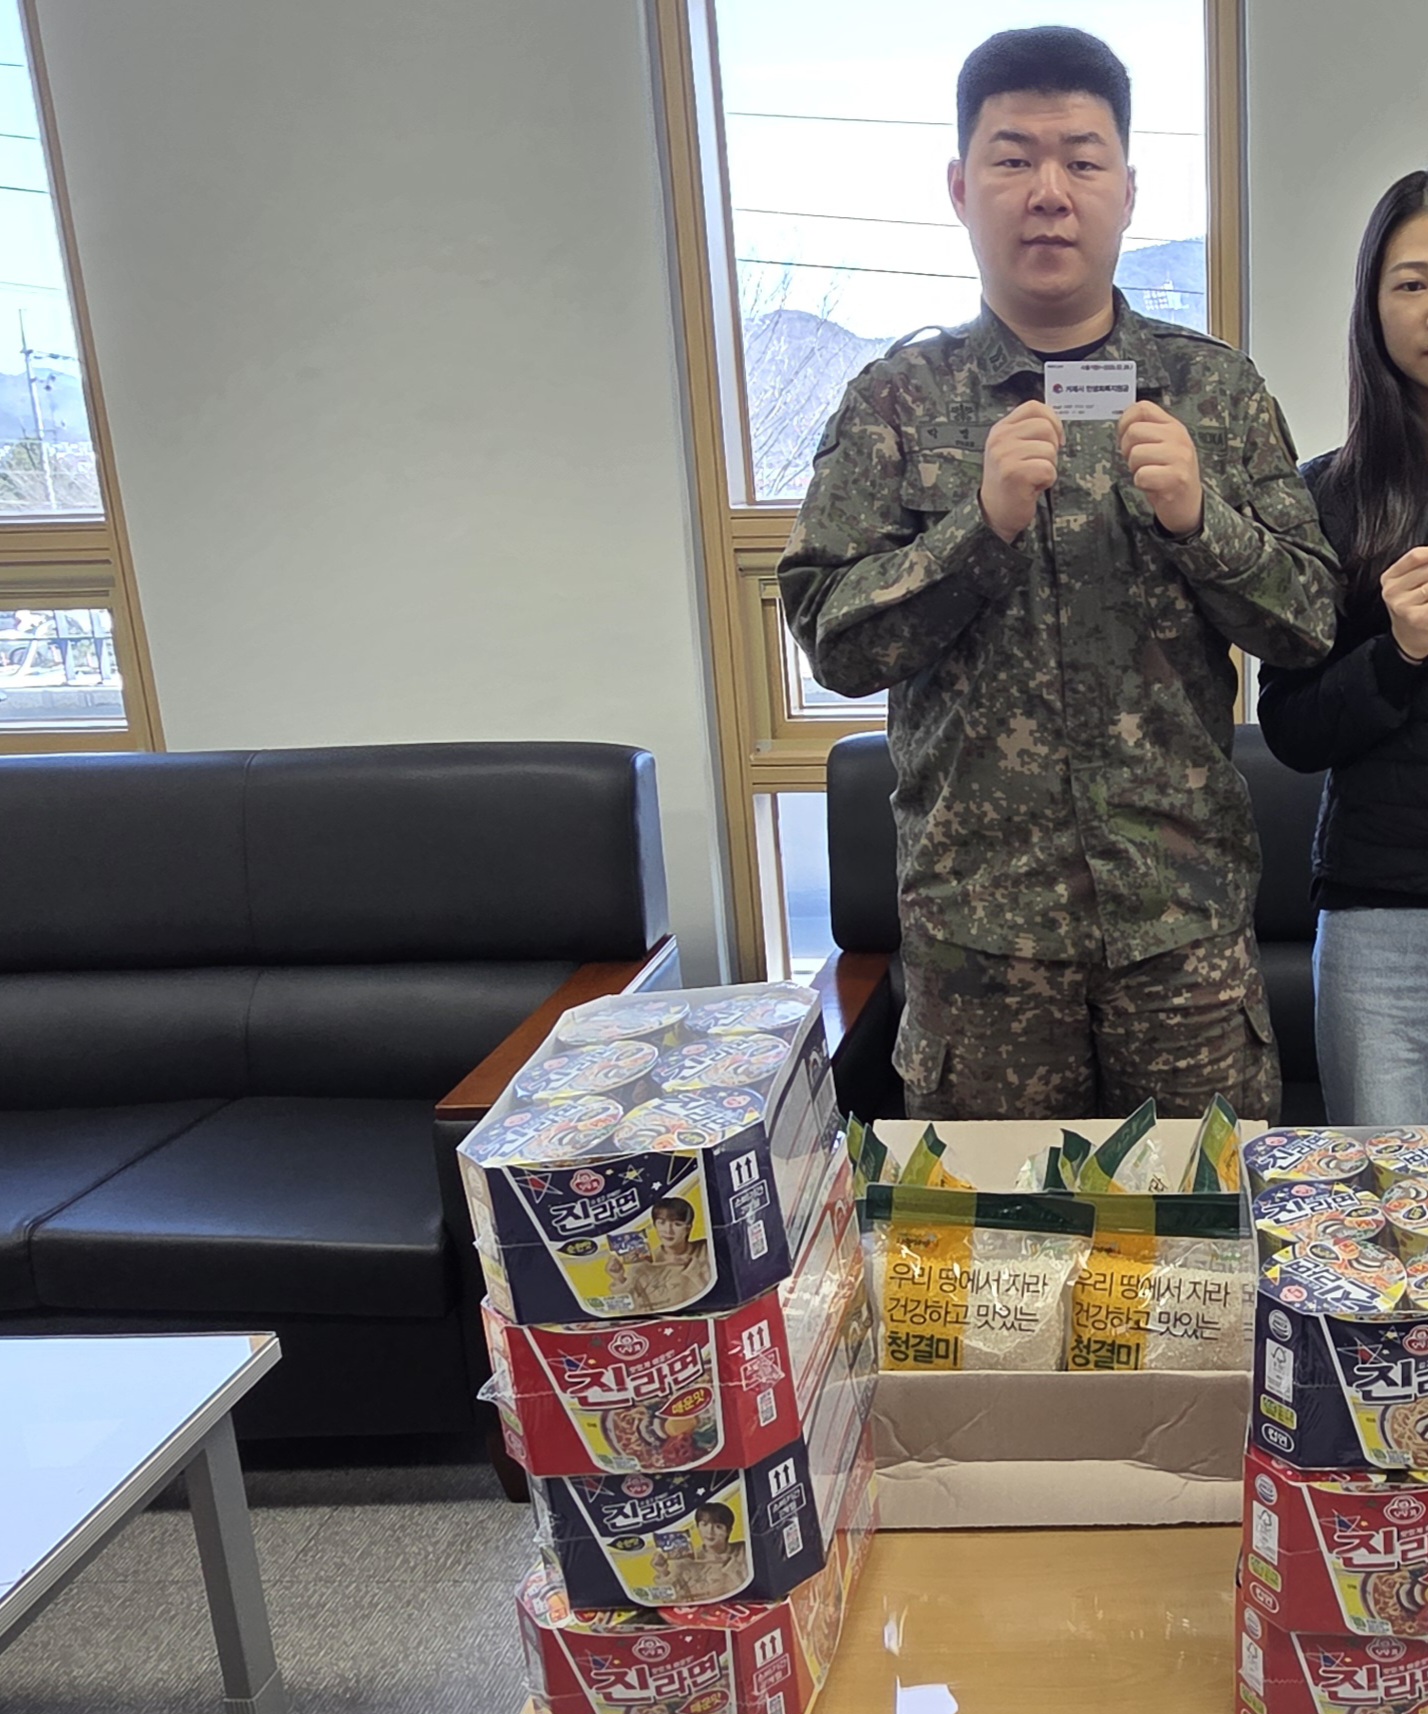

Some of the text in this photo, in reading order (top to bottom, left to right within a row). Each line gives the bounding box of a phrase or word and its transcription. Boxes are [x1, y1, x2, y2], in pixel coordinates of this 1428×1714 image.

[550, 1187, 641, 1236] 진라면
[889, 1262, 1049, 1299] 우리 땅에서 자라
[1074, 1267, 1231, 1308] 우리 땅에서 자라
[888, 1296, 1039, 1333] 건강하고 맛있는
[1072, 1301, 1222, 1341] 건강하고 맛있는
[887, 1331, 960, 1366] 청결미
[1070, 1333, 1141, 1371] 청결미
[565, 1343, 706, 1411] 진라면
[671, 1390, 706, 1415] 매운맛
[603, 1492, 686, 1531] 진라면
[590, 1650, 723, 1705] 진라면
[688, 1692, 724, 1714] 매운맛
